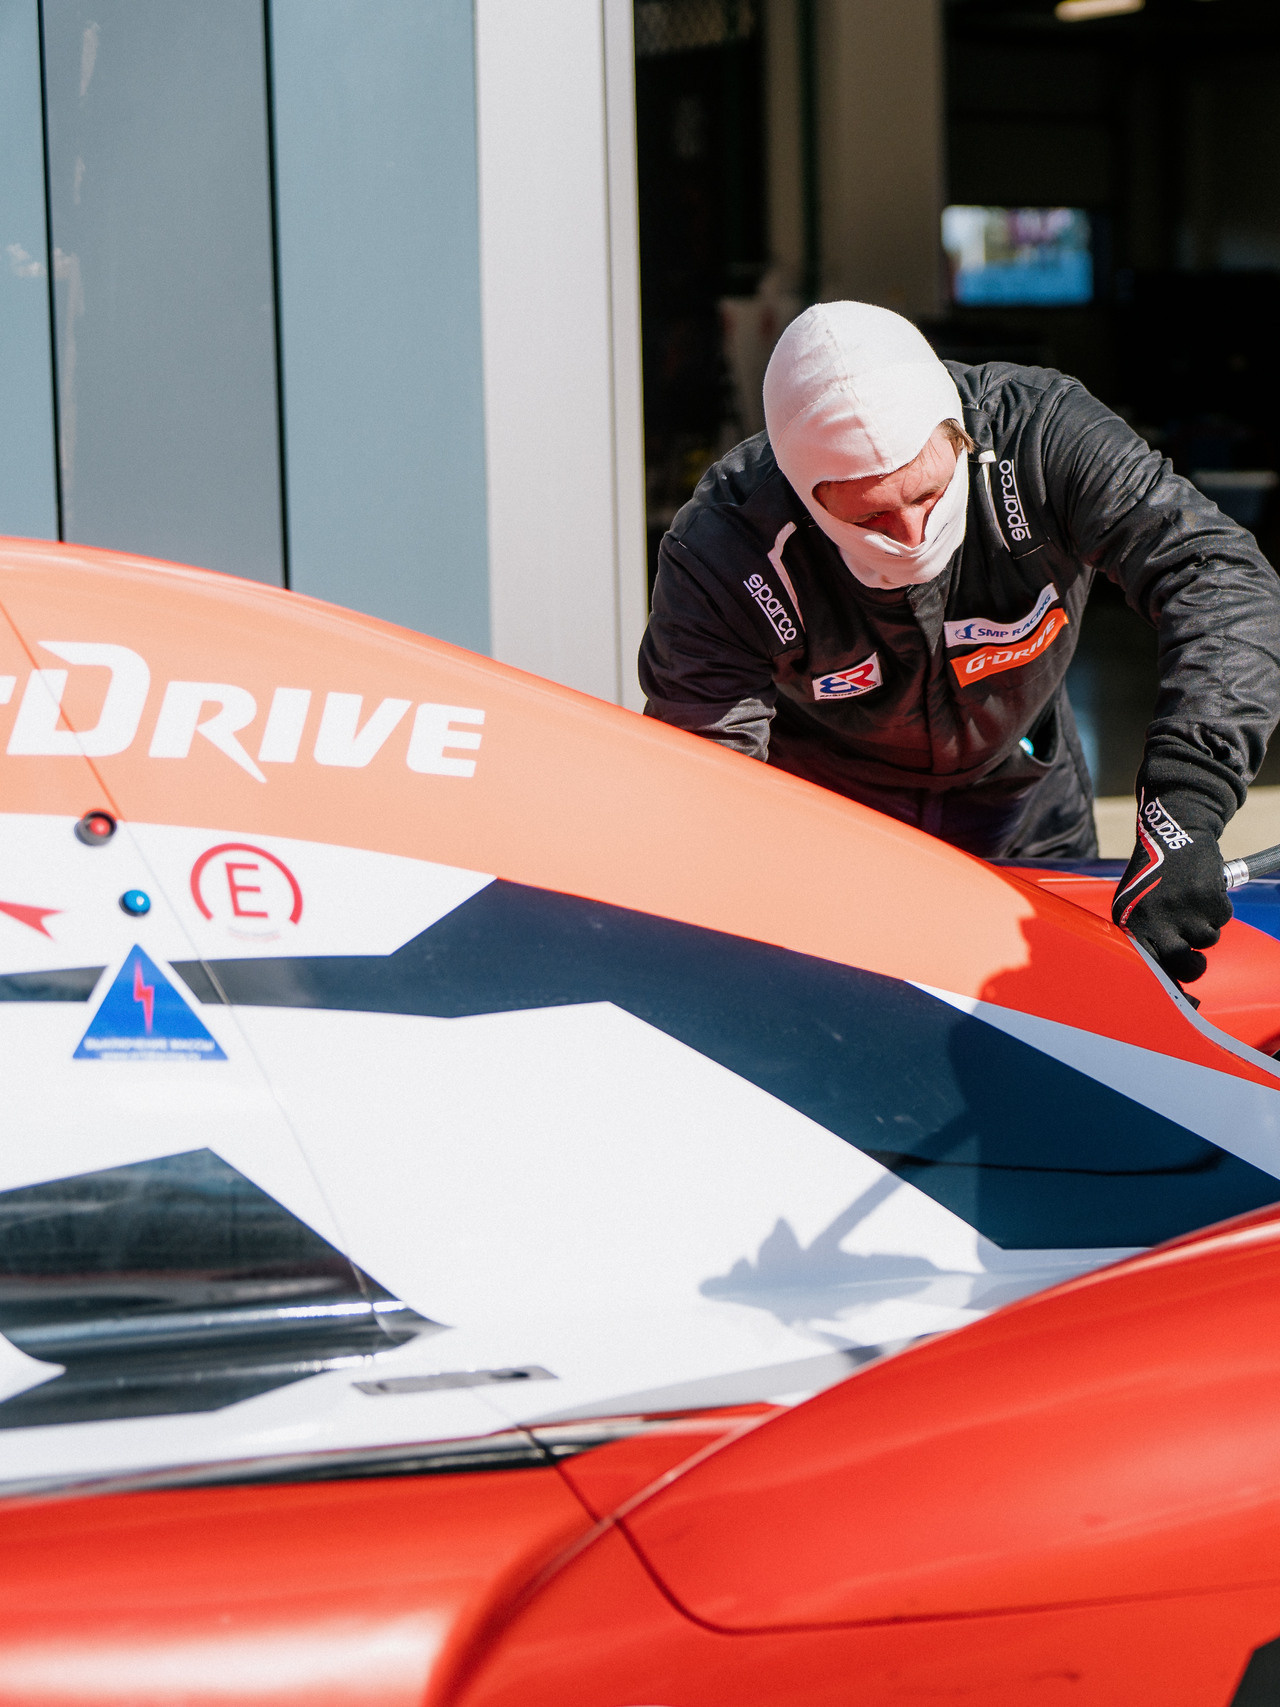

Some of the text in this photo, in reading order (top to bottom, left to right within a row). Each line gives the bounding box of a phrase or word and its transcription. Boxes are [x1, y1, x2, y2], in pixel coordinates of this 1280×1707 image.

[998, 459, 1030, 542] sparco
[745, 573, 798, 642] sparco
[977, 594, 1051, 639] SMP RACING
[1144, 800, 1191, 850] sparco
[225, 862, 268, 918] E
